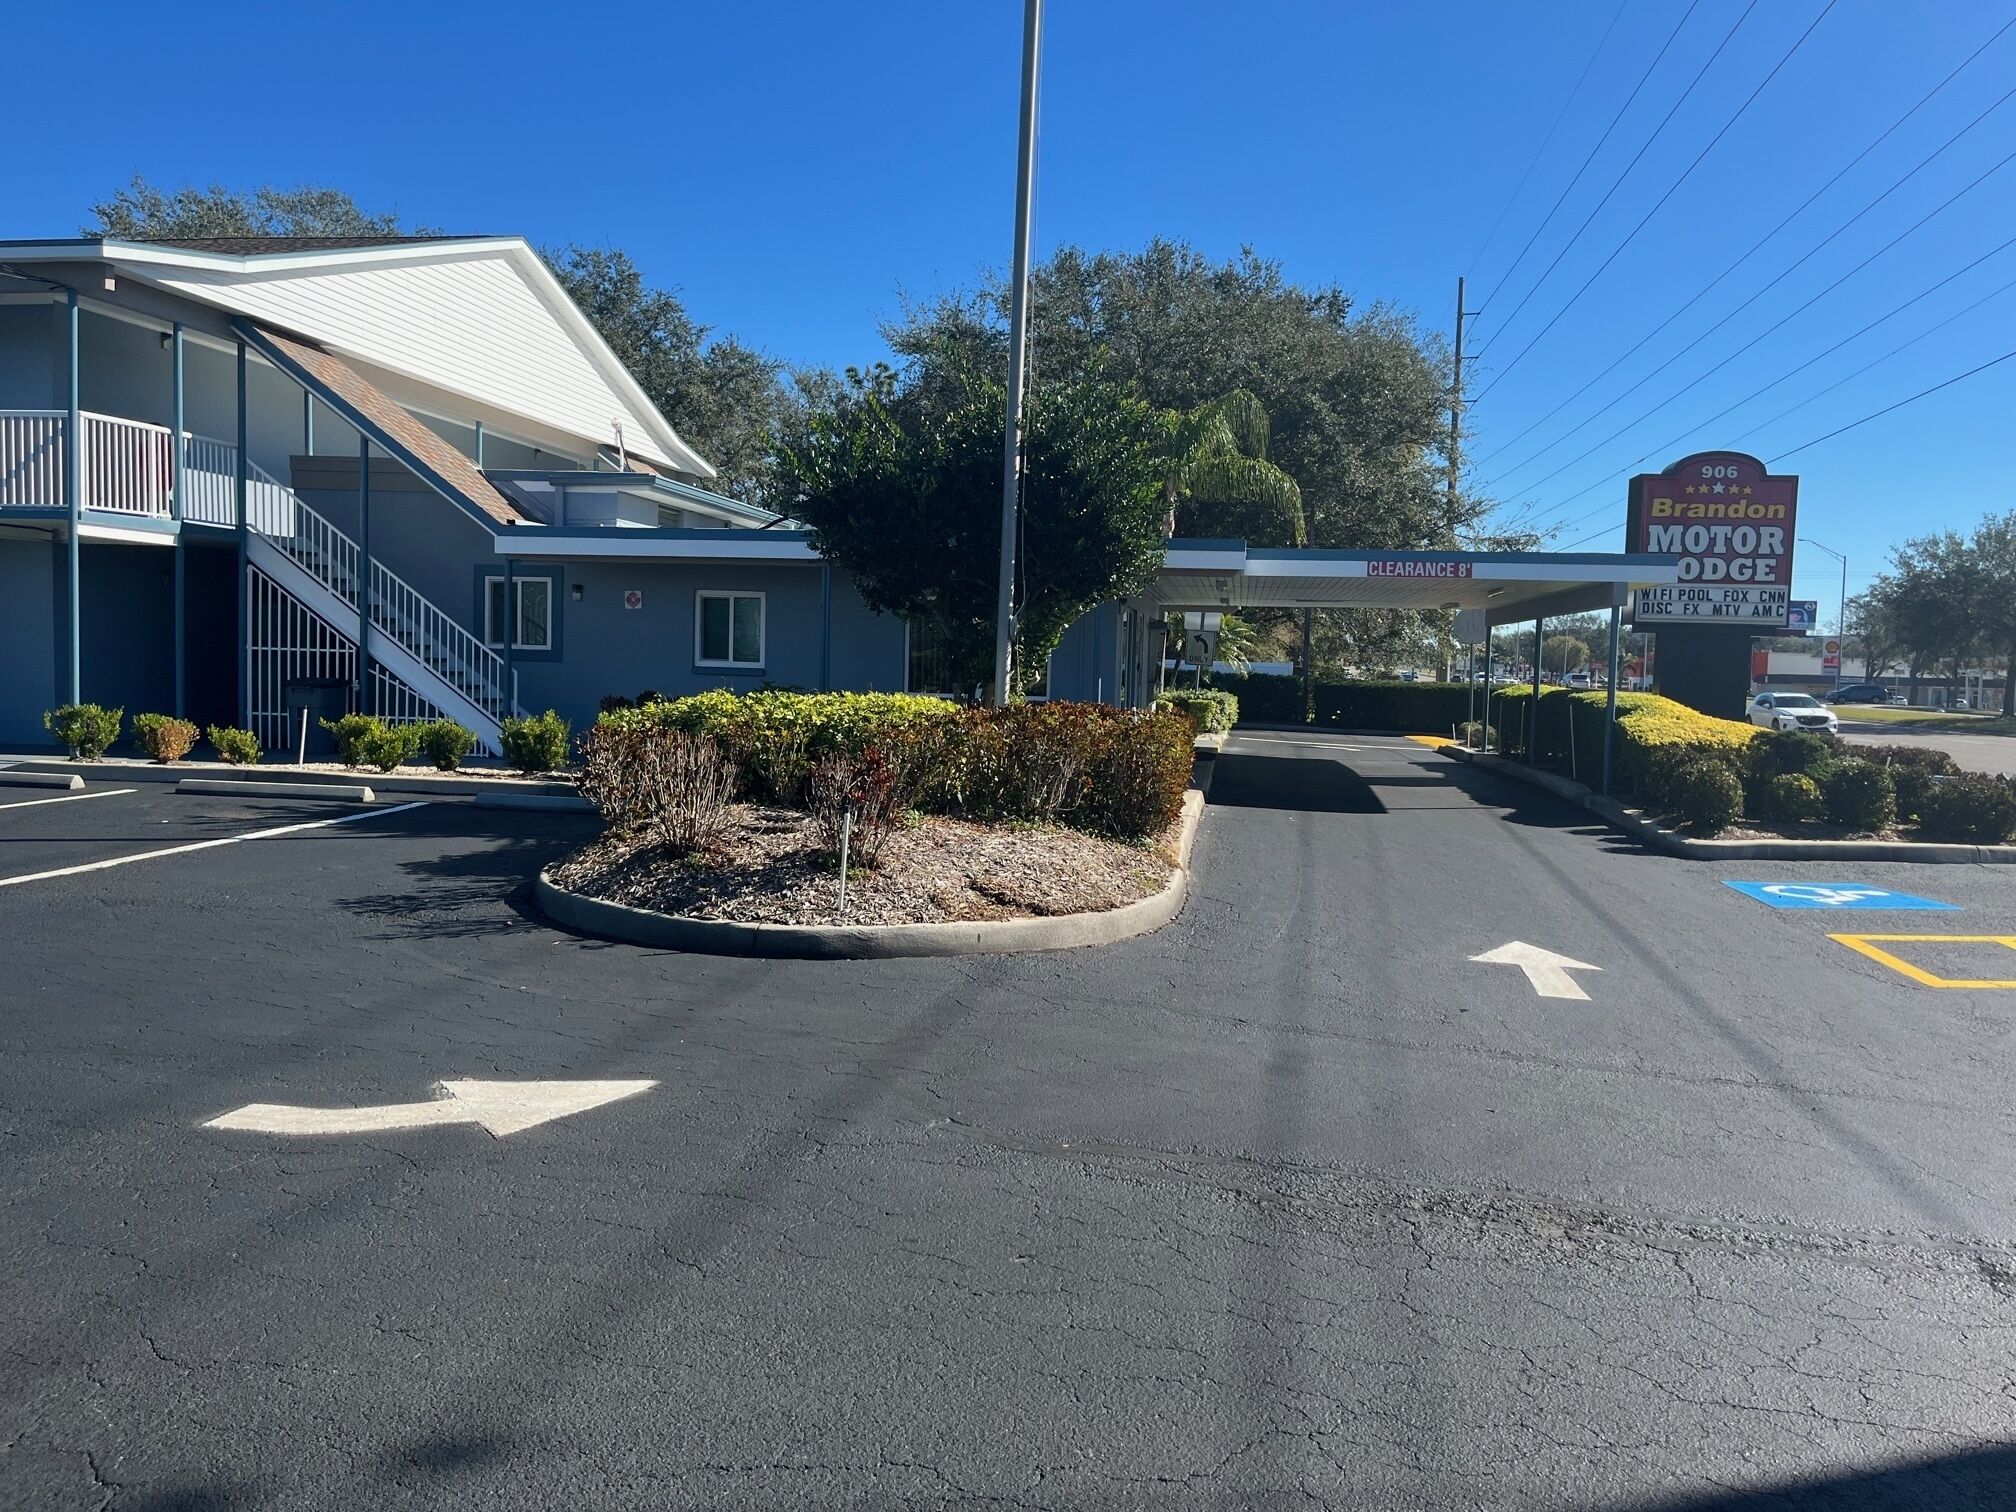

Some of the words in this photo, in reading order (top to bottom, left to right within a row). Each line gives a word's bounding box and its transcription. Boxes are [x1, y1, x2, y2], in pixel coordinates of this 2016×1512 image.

[1701, 465, 1738, 479] 906
[1651, 498, 1786, 519] Brandon
[1647, 524, 1784, 555] MOTOR
[1368, 561, 1455, 577] CLEARANCE
[1458, 563, 1471, 577] 8'
[1677, 556, 1777, 581] ODGE
[1678, 589, 1713, 601] POOL
[1723, 590, 1749, 602] FOX
[1759, 591, 1786, 603] CNN
[1642, 602, 1673, 614] DISC
[1683, 603, 1700, 615] FX
[1712, 604, 1741, 616] MTV
[1751, 605, 1785, 617] AMC
